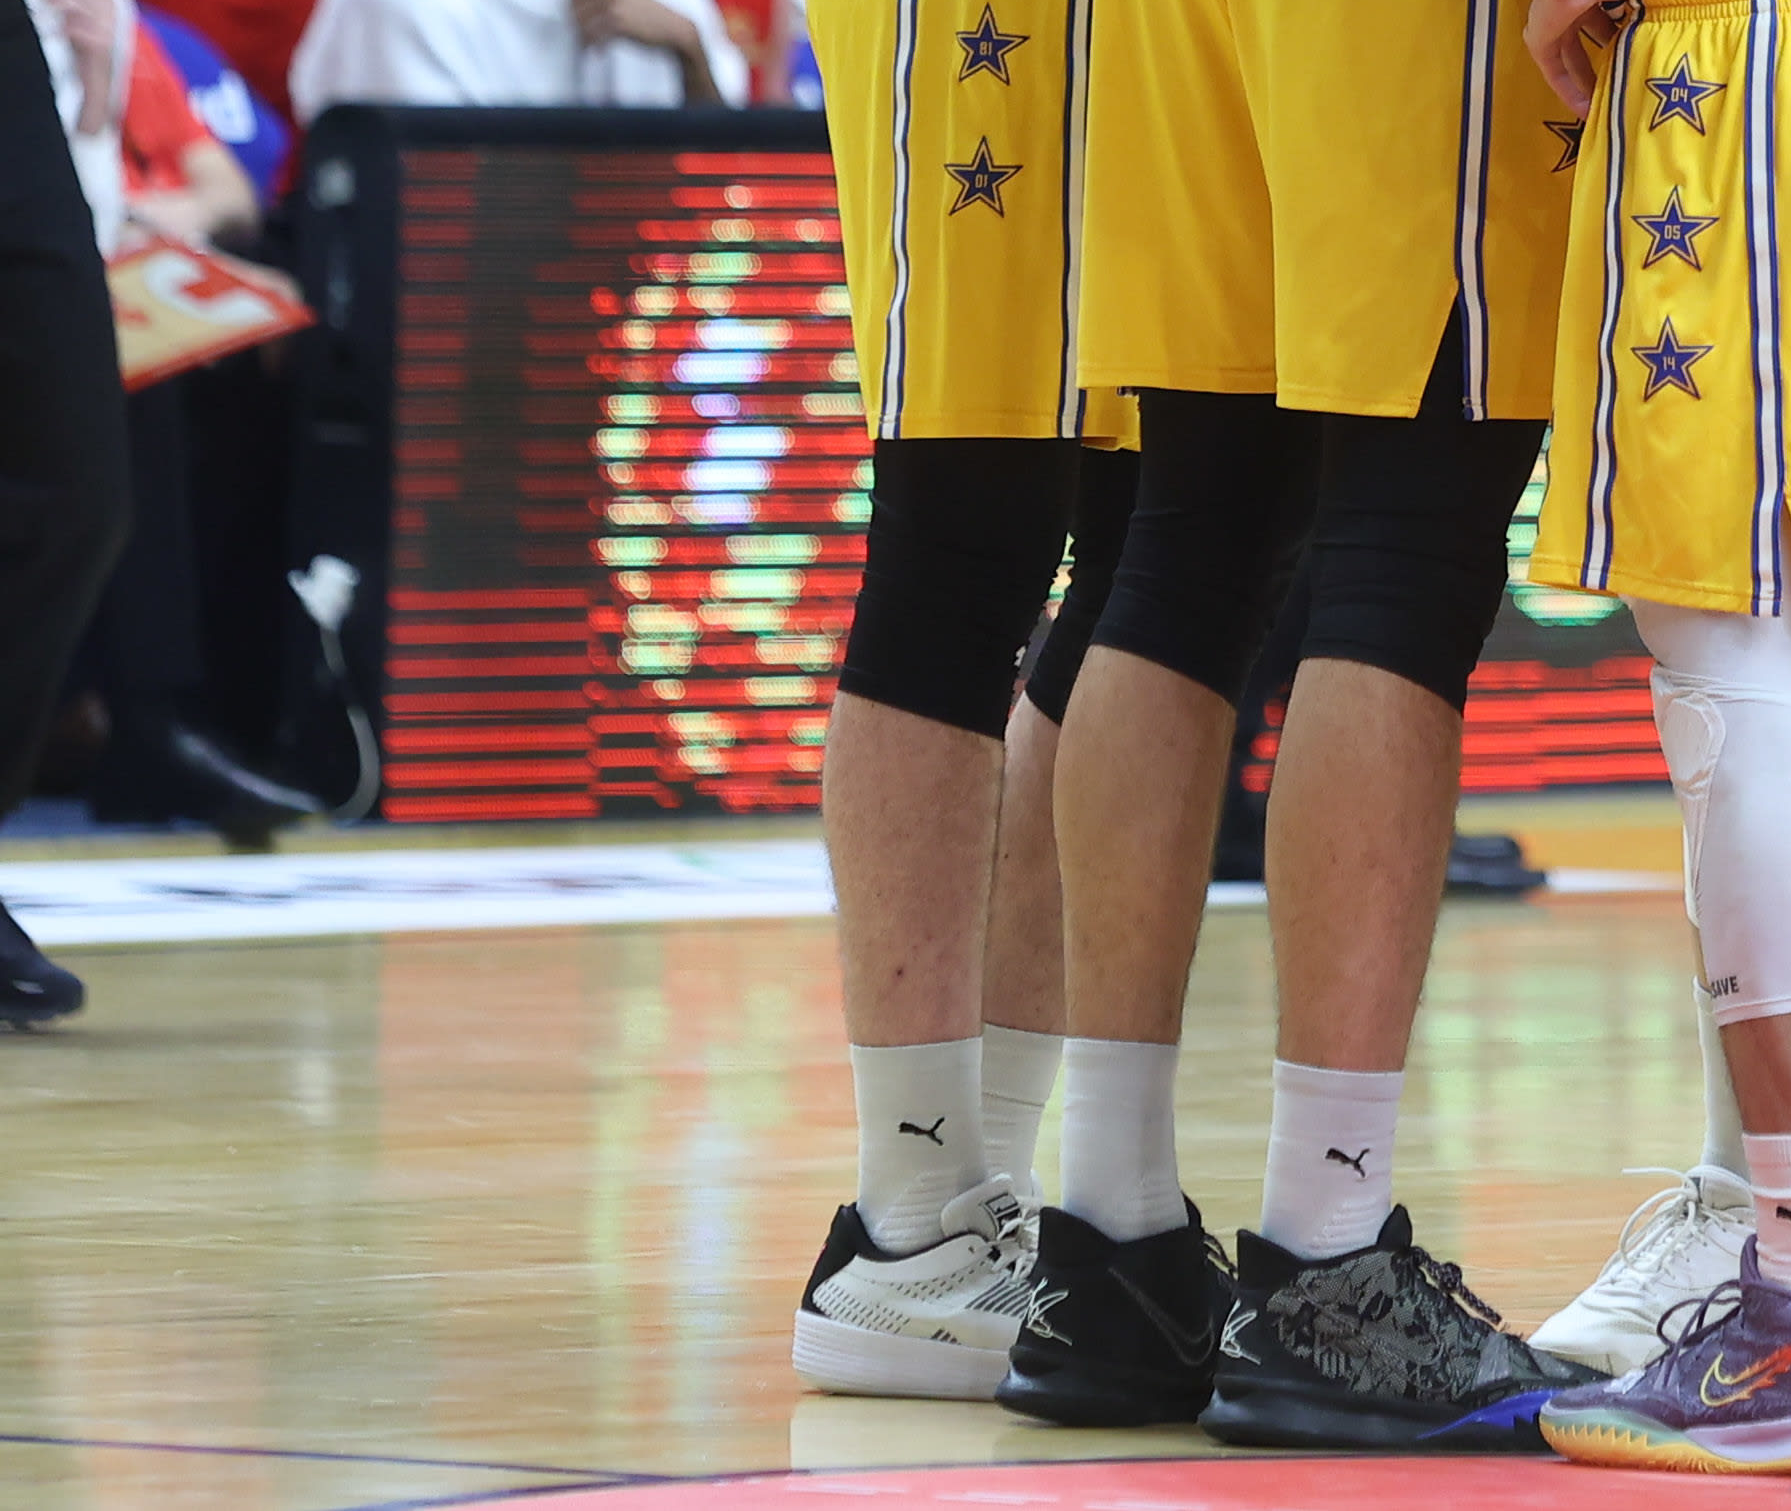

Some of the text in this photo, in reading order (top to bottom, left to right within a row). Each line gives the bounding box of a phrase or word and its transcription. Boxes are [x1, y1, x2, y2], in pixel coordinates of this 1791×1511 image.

[979, 41, 992, 56] 81
[1671, 86, 1690, 104] 04
[1664, 224, 1682, 240] 05
[1663, 356, 1676, 372] 14
